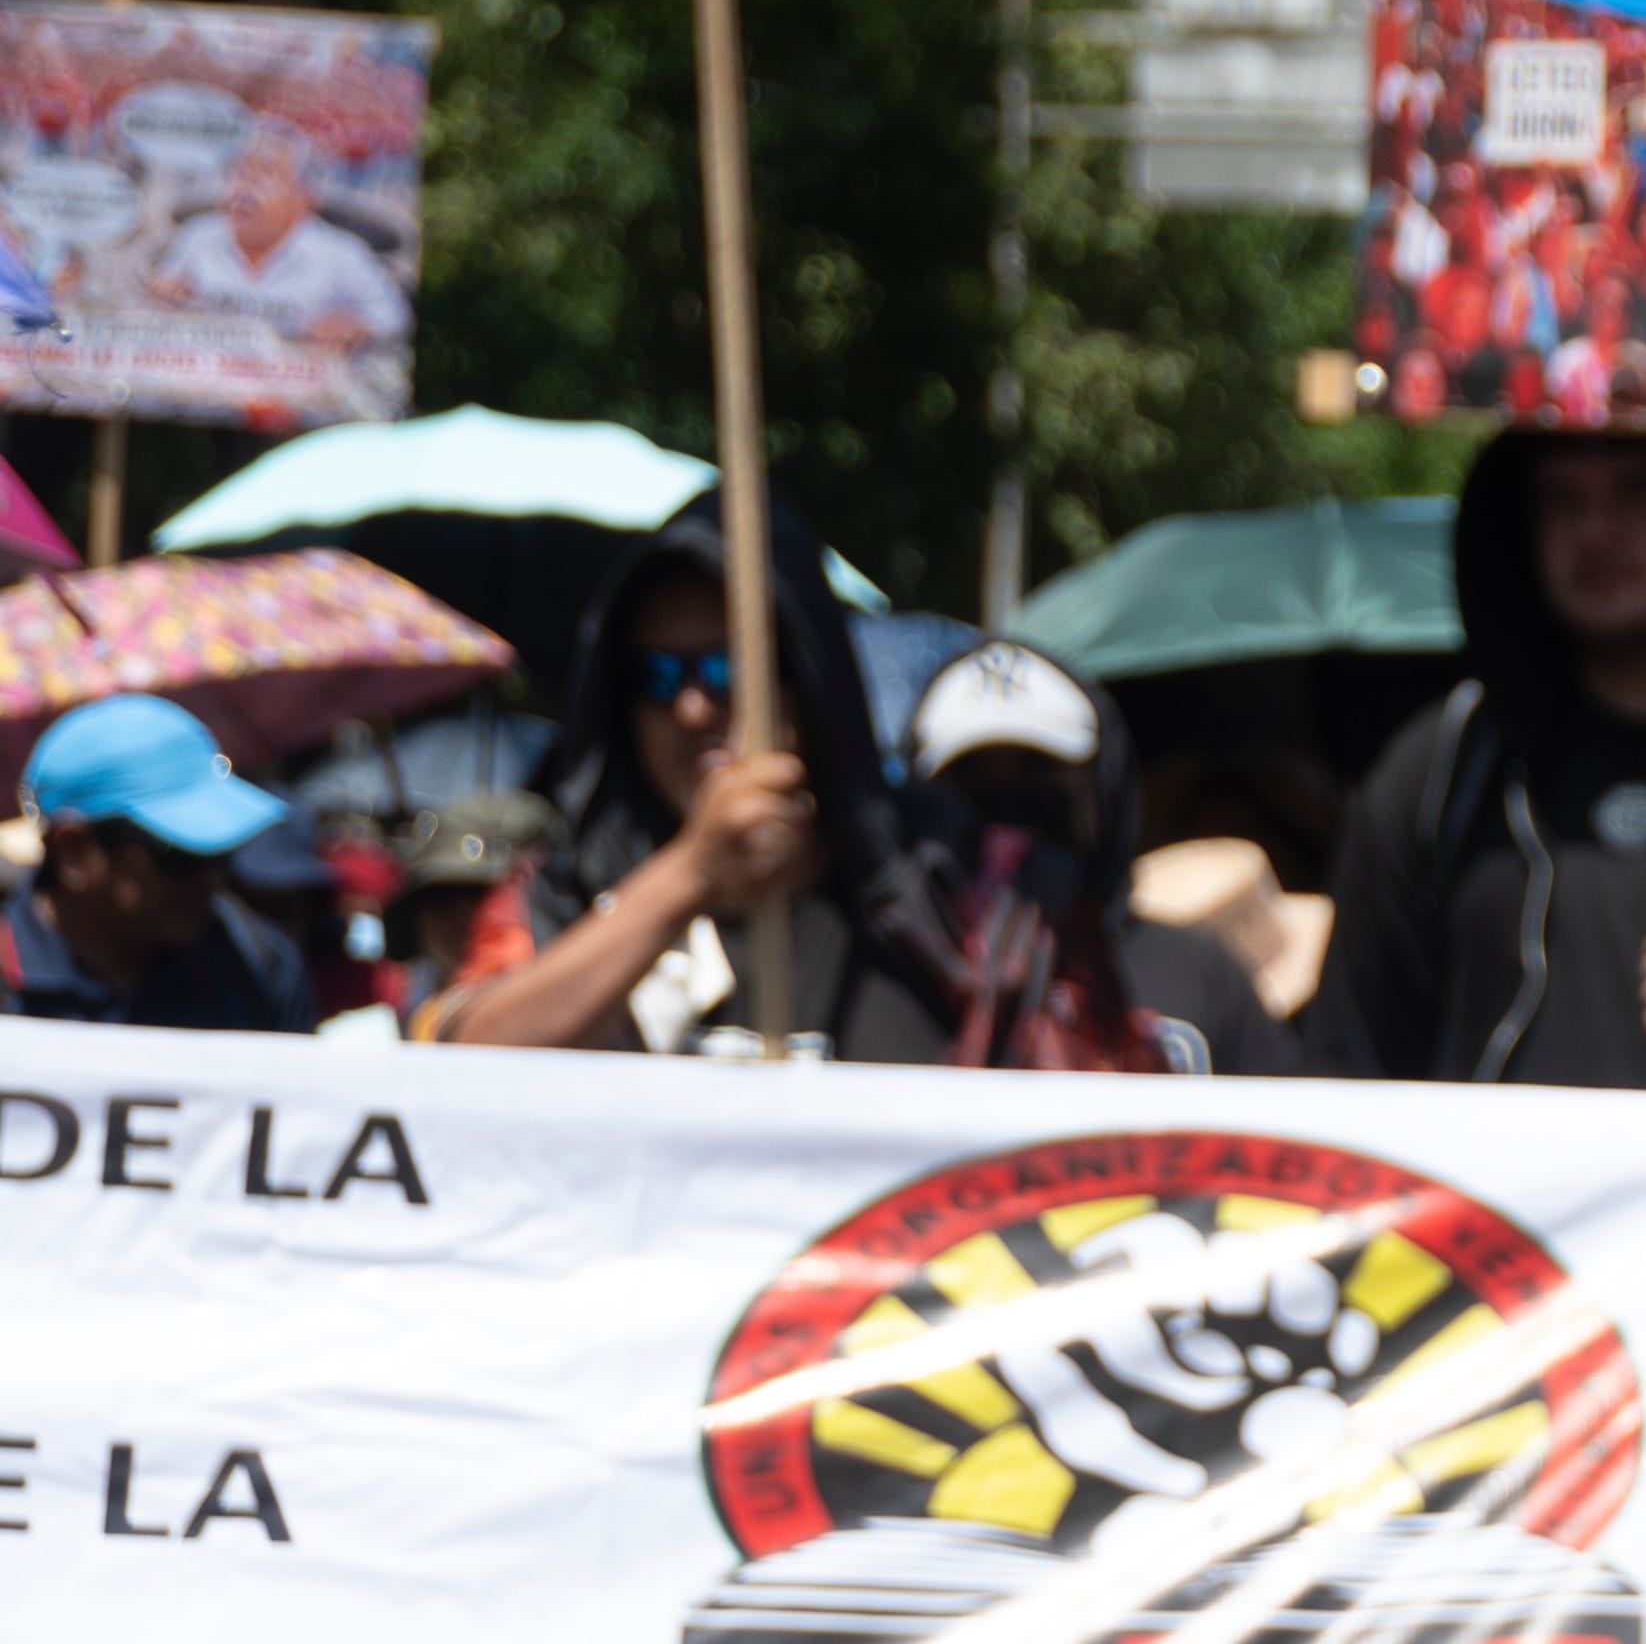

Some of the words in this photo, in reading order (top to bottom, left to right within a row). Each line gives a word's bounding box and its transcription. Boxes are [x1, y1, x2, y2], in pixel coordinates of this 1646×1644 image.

[0, 1090, 181, 1193] DE
[244, 1104, 431, 1207] LA
[103, 1442, 293, 1544] LA
